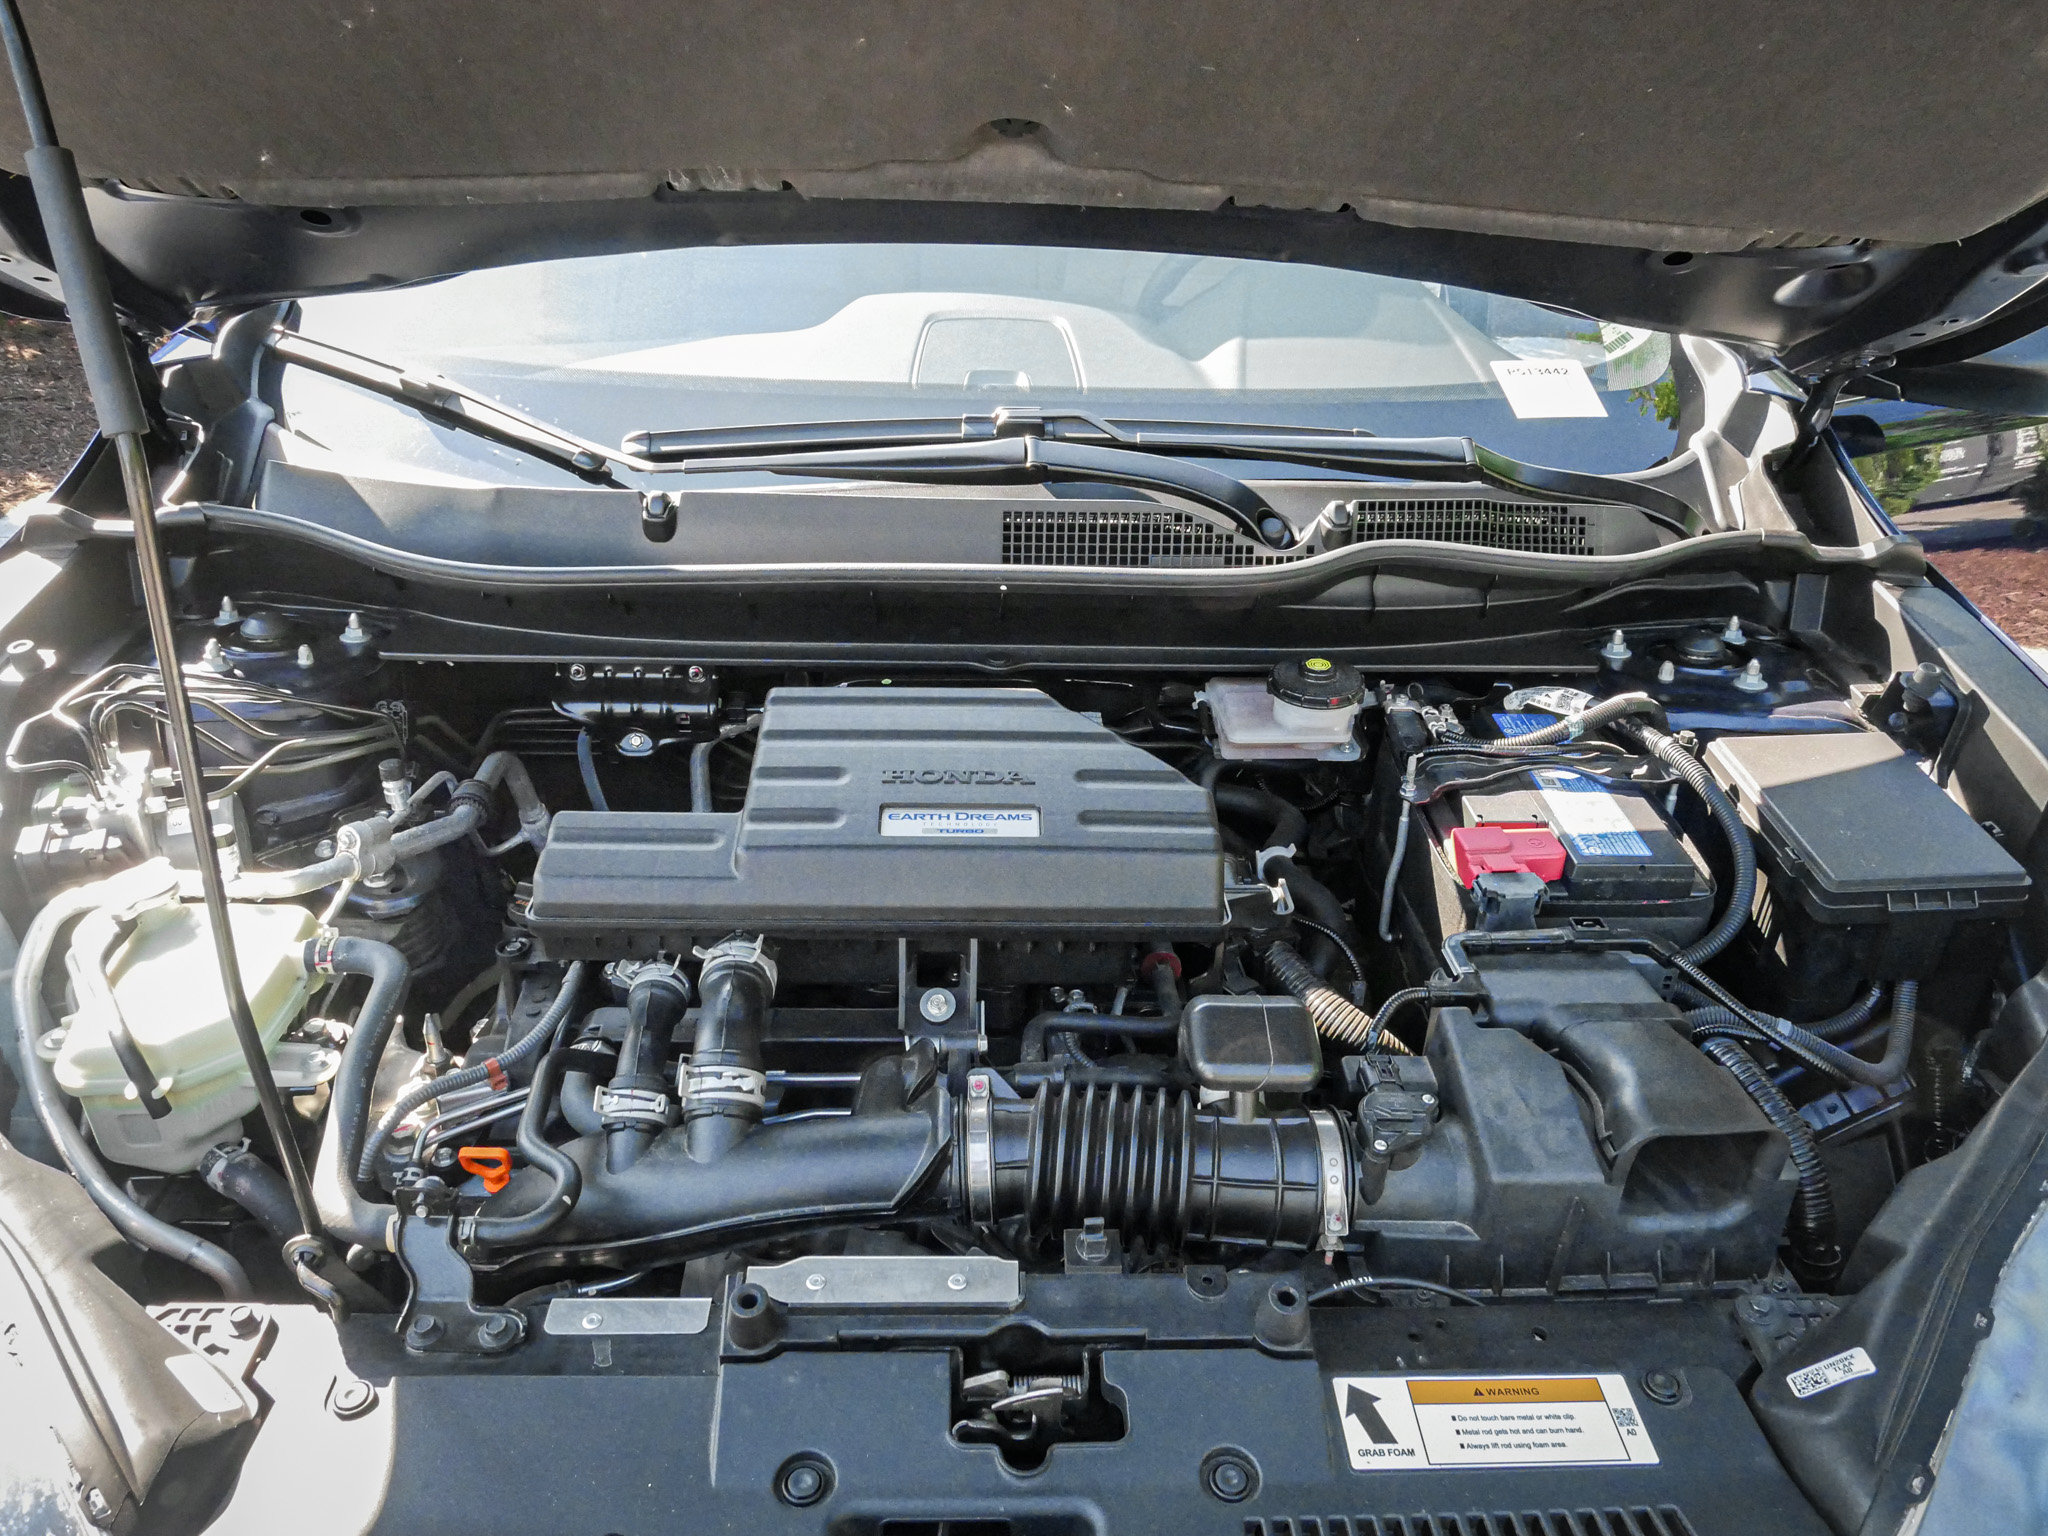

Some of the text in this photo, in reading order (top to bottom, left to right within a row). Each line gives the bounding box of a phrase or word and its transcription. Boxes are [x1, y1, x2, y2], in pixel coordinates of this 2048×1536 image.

[881, 769, 1036, 786] HONDA
[888, 813, 950, 821] EARTH
[1486, 1387, 1540, 1396] WARNING
[1494, 1429, 1509, 1437] gets
[1466, 1443, 1490, 1451] Always
[1513, 1442, 1532, 1450] using
[1358, 1448, 1416, 1457] GRAB FOAM
